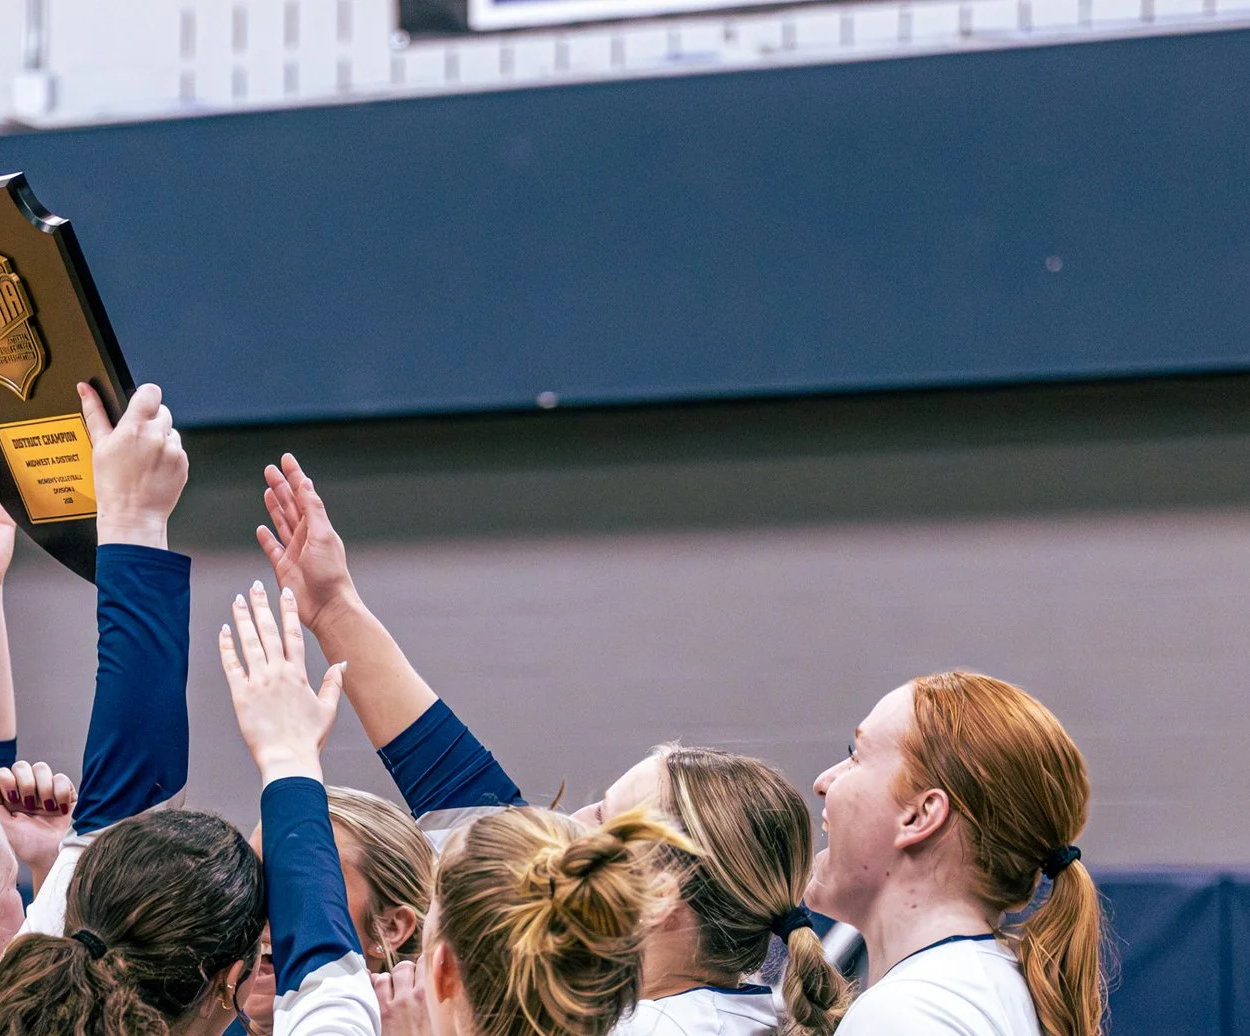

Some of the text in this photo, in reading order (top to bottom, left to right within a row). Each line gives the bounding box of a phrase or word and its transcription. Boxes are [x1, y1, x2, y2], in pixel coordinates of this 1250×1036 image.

[11, 431, 77, 449] DISTRICT CHAMPION
[25, 457, 50, 467] MIDWEST
[55, 453, 79, 464] DISTRICT
